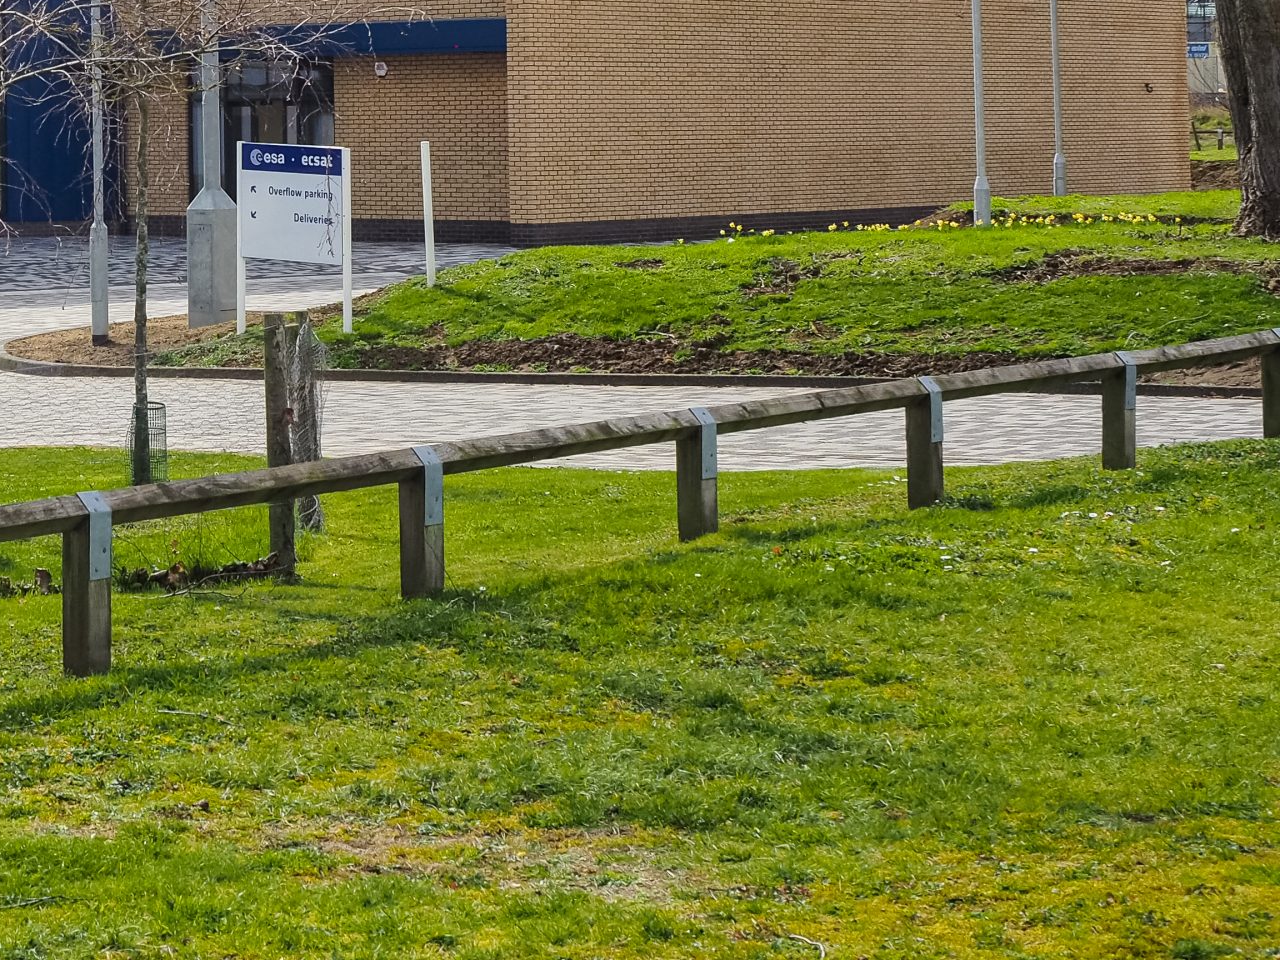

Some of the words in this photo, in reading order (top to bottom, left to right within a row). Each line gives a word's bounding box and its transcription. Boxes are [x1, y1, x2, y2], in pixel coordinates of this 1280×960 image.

[263, 153, 285, 164] esa
[301, 155, 333, 167] ecsat
[268, 186, 302, 197] Overflow
[304, 189, 333, 201] parking
